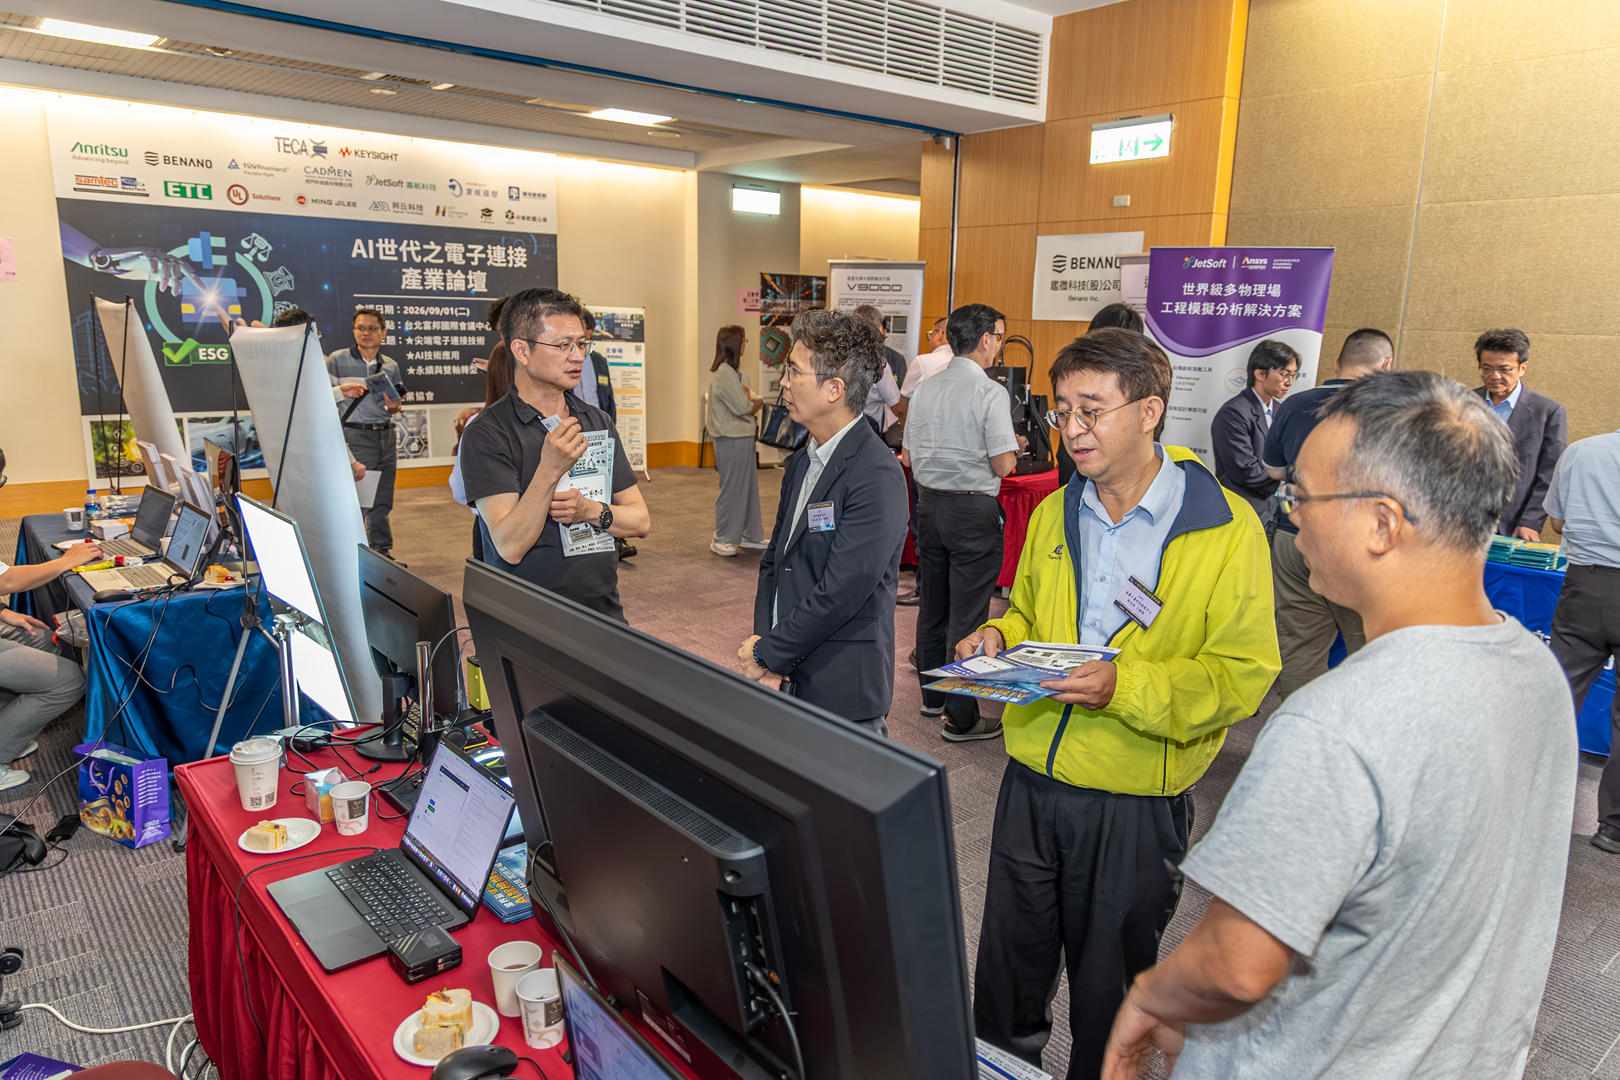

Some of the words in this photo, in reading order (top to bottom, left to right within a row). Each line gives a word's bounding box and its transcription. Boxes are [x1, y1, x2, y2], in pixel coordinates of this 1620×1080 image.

[71, 141, 129, 158] Anritsu
[274, 136, 308, 155] TECA
[353, 149, 399, 161] KEYSIGHT
[303, 166, 353, 178] CADMEN
[166, 183, 210, 199] ETC
[351, 238, 528, 268] AI世代之電子連接
[1191, 257, 1227, 269] JetSoft
[400, 267, 488, 292] 產業論壇
[1182, 282, 1281, 298] 世界級多物理場
[1160, 301, 1303, 319] 工程模擬分析解決方案
[198, 347, 230, 361] ESG
